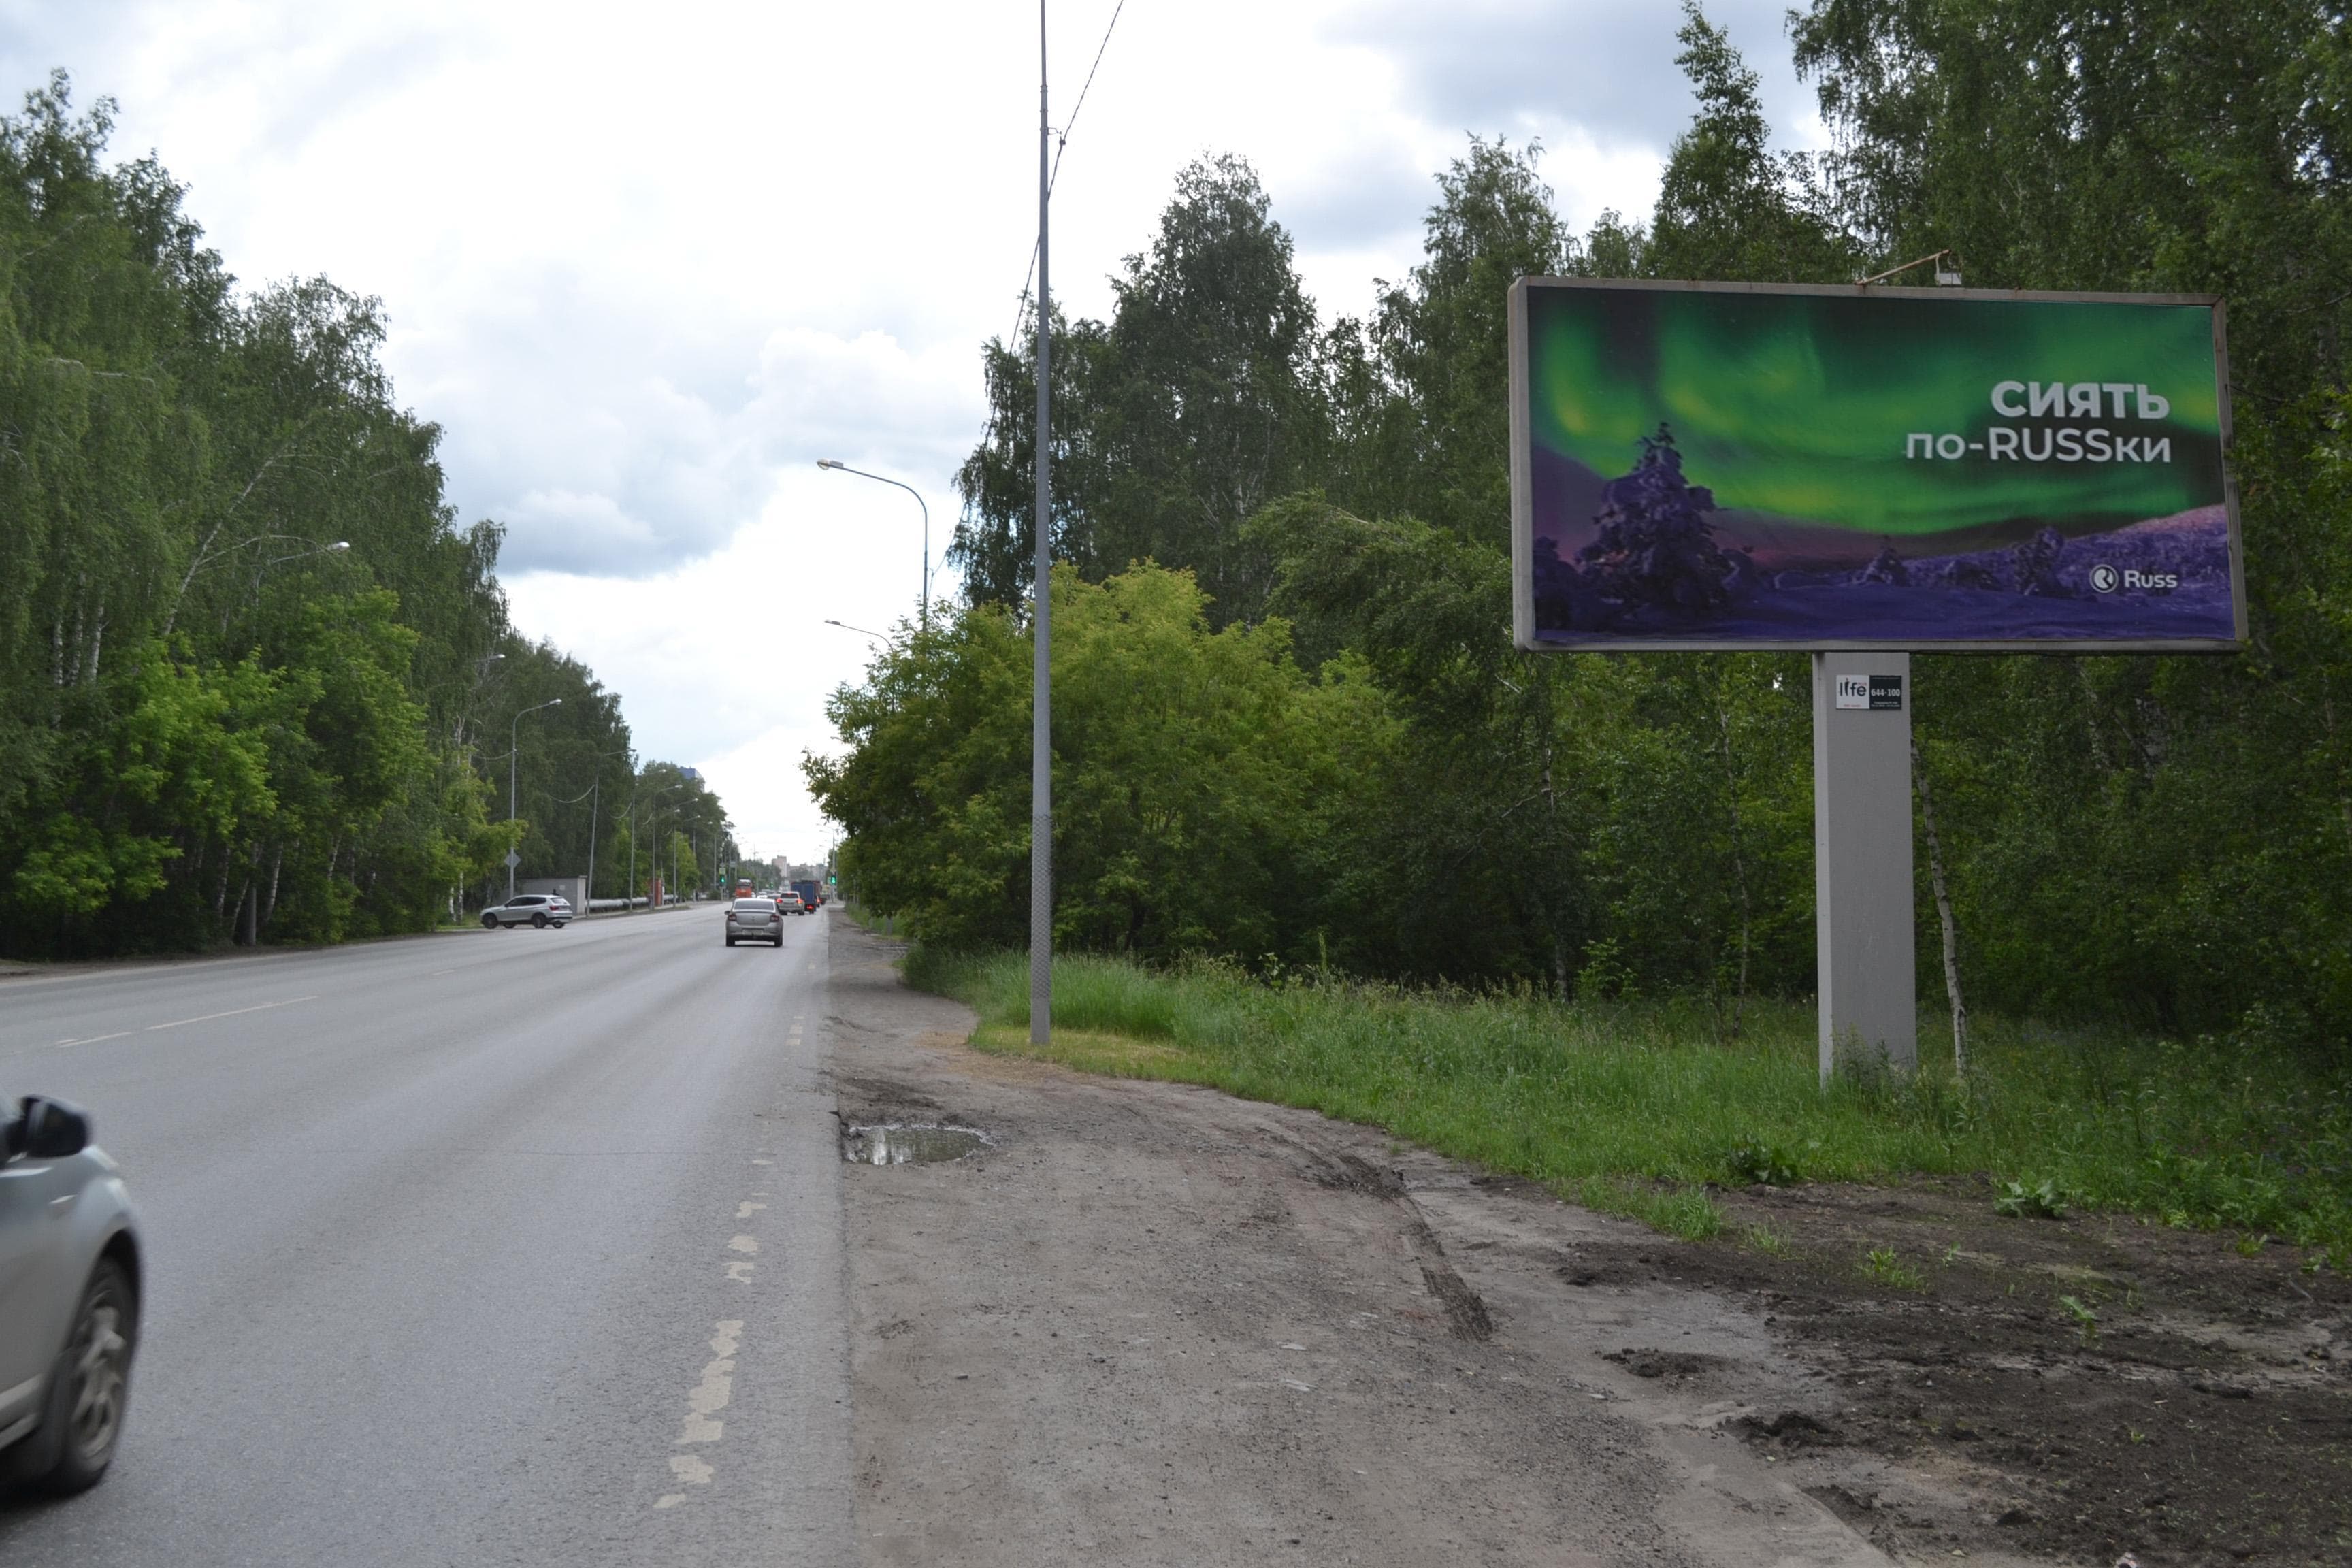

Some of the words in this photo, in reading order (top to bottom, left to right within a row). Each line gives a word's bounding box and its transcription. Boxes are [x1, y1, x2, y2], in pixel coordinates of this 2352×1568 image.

[1991, 380, 2170, 419] СИЯТЬ
[1906, 427, 2171, 463] по-RUSSки
[2124, 570, 2178, 589] Russ
[1840, 678, 1867, 697] life
[1871, 688, 1901, 697] 644-100
